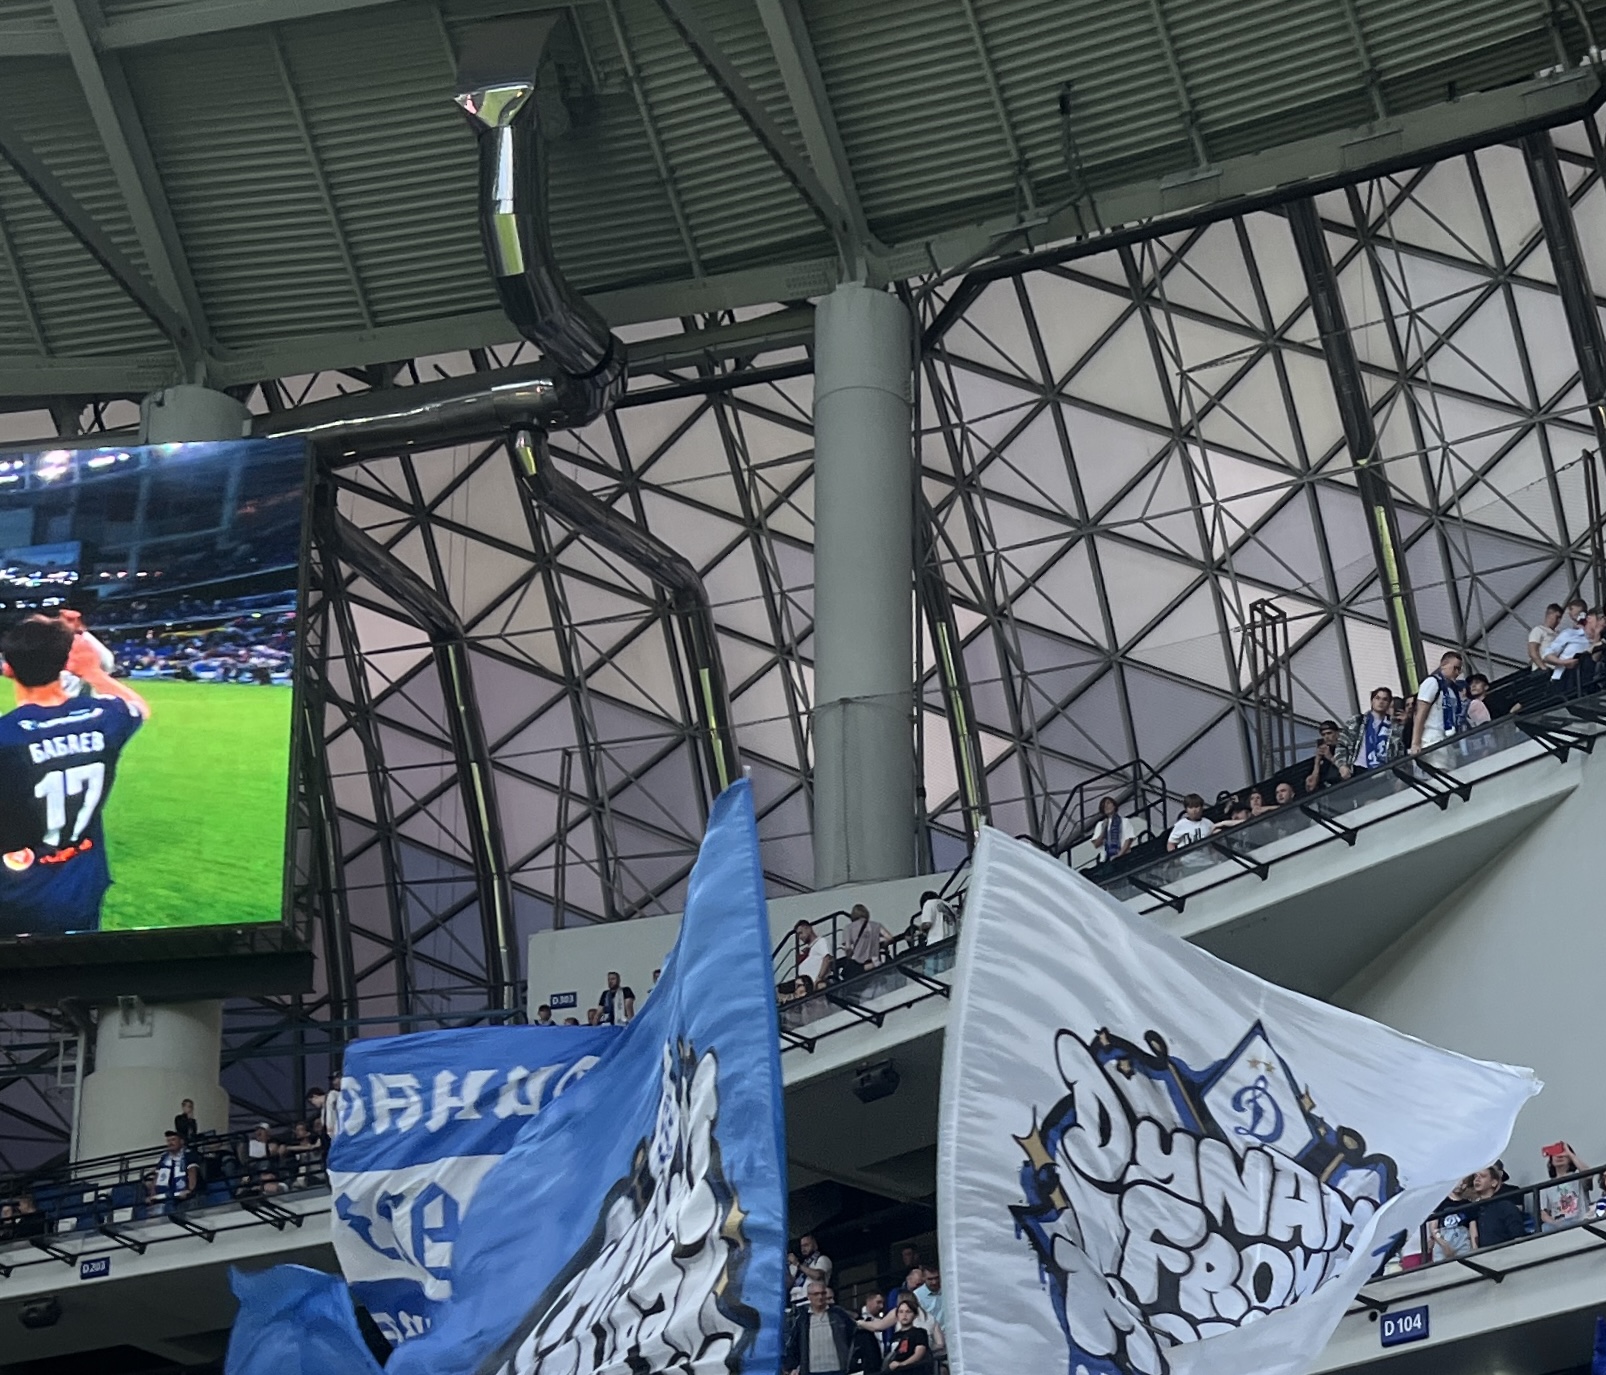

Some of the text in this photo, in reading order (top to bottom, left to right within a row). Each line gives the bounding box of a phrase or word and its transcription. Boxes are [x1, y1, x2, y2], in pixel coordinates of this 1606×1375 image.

[29, 731, 105, 764] БАБАЕВ
[34, 762, 105, 846] 17
[1384, 1313, 1422, 1337] D 104
